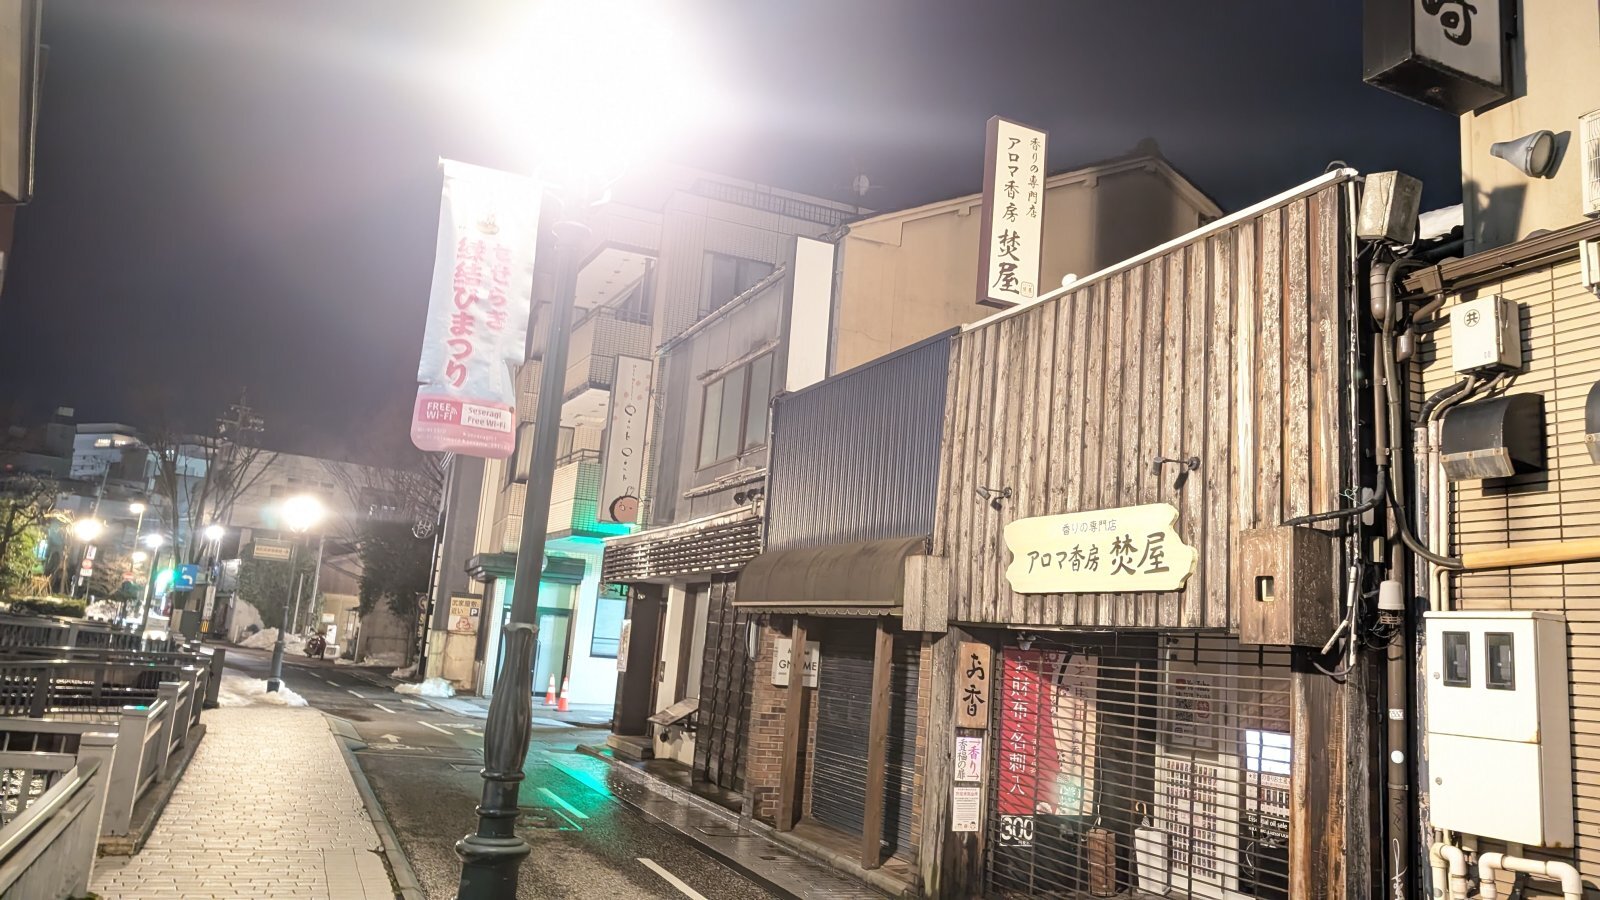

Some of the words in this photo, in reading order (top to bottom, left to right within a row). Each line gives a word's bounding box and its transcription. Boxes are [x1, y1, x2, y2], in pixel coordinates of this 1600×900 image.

[1003, 137, 1021, 223] アロマ香房
[1026, 137, 1041, 219] 香りの専門店
[993, 229, 1020, 294] 焚屋
[444, 236, 487, 388] 縁結びまつり
[427, 401, 451, 412] FREE
[467, 415, 485, 426] Free
[468, 407, 502, 419] Seseragi
[1062, 519, 1118, 536] 香りの専門店
[1027, 543, 1100, 574] アロマ香房
[1109, 531, 1170, 576] 焚屋
[779, 660, 817, 671] GNME
[963, 653, 985, 716] お香
[1001, 816, 1034, 841] 300
